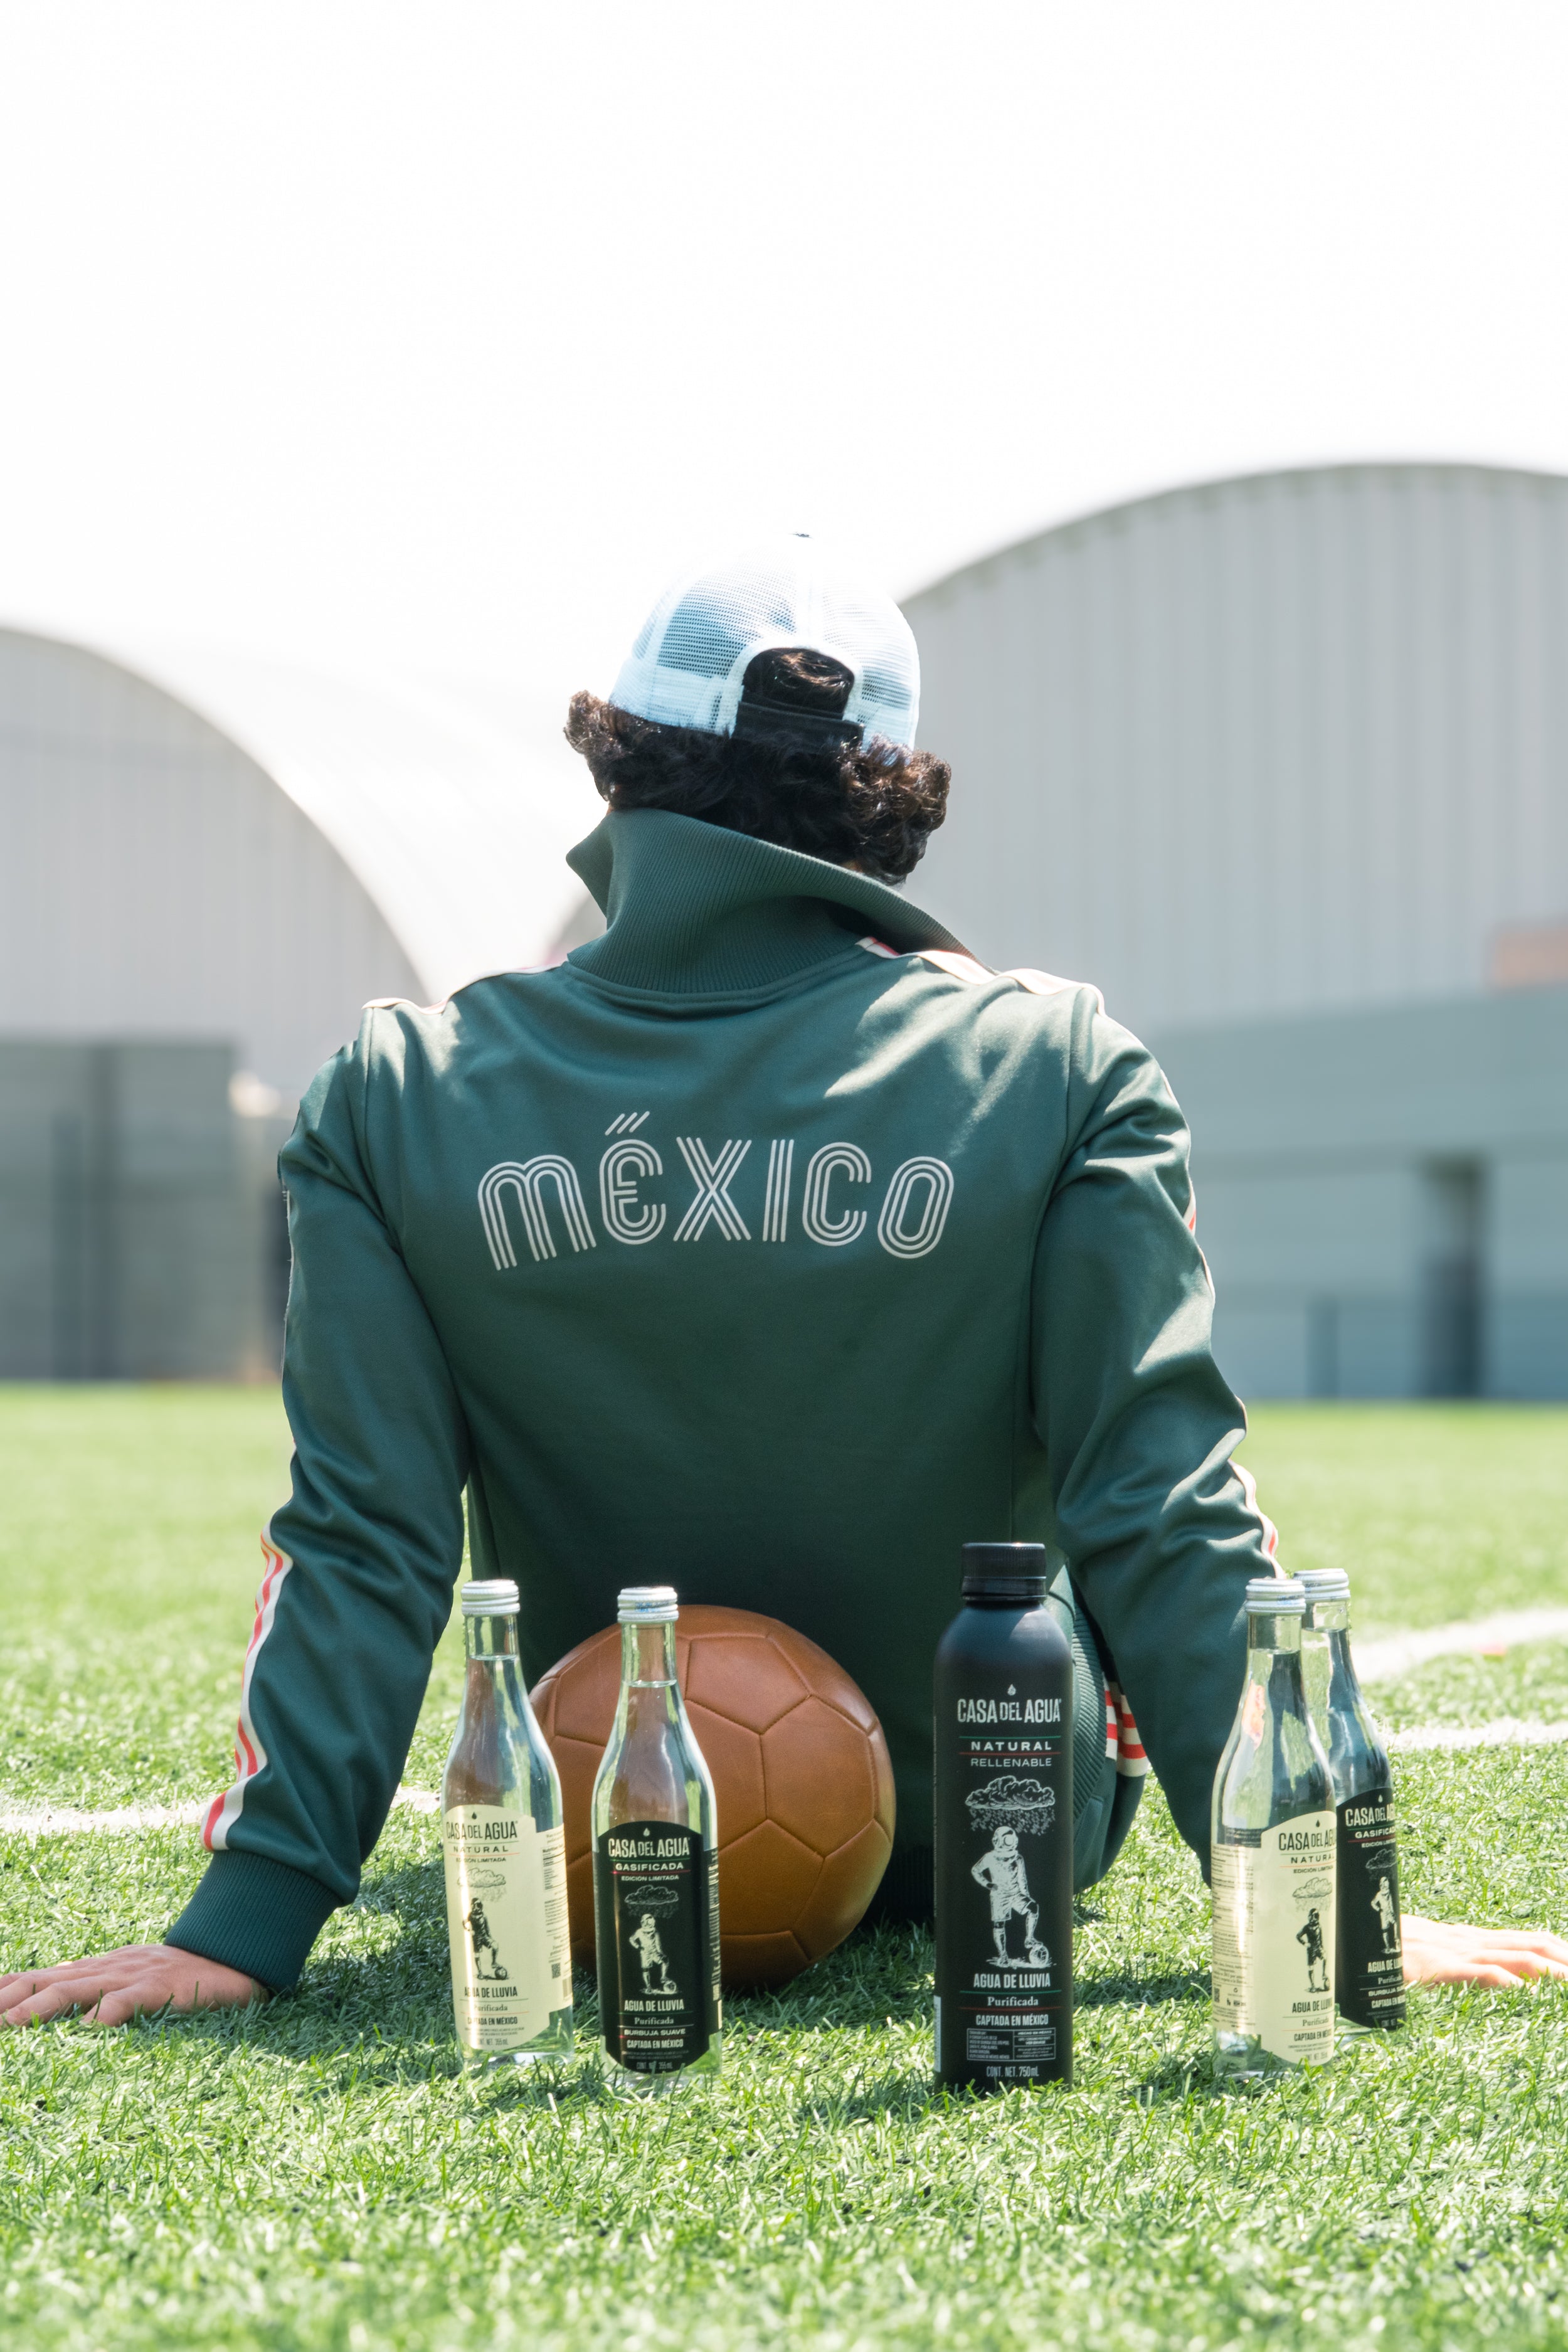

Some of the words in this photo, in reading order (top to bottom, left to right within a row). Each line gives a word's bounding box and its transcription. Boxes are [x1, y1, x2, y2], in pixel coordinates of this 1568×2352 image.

[477, 1111, 955, 1271] MÉXICO
[957, 1698, 998, 1723] CASA
[1000, 1702, 1022, 1720] DEL
[1024, 1698, 1061, 1723] AGUA
[971, 1741, 1052, 1751] NATURAL
[971, 1758, 1052, 1767] RELLENABLE
[1345, 1807, 1375, 1826] CASA
[1375, 1807, 1386, 1822] DEL
[446, 1821, 467, 1840] CASA
[467, 1825, 483, 1838] DEL
[485, 1821, 517, 1840] AGUA
[608, 1838, 637, 1858] CASA
[638, 1841, 655, 1856] DEL
[657, 1837, 690, 1858] AGUA
[1279, 1832, 1310, 1851] CASA
[1311, 1833, 1323, 1847] DEL
[453, 1845, 509, 1853] NATURAL
[615, 1862, 684, 1871] GASIFICADA
[1367, 1960, 1385, 1973] AGUA
[973, 1973, 1001, 1988] AGUA
[1004, 1974, 1017, 1988] DE
[1019, 1973, 1051, 1988] LLUVIA
[481, 1987, 490, 1998] DE
[492, 1986, 518, 1998] LLUVIA
[624, 2000, 644, 2011] AGUA
[645, 2001, 655, 2011] DE
[657, 1999, 684, 2011] LLUVIA
[987, 1996, 1039, 2006] Purificada
[1292, 2001, 1311, 2013] AGUA
[1313, 2000, 1320, 2011] DE
[496, 2016, 518, 2025] MÉXICO
[635, 2016, 674, 2025] Purificada
[976, 2015, 1010, 2026] CAPTADA
[1011, 2015, 1021, 2026] EN
[1022, 2013, 1049, 2026] MÉXICO
[1294, 2032, 1316, 2042] CAPTADA
[627, 2040, 652, 2049] CAPTADA
[652, 2040, 660, 2048] EN
[661, 2038, 684, 2048] MÉXICO
